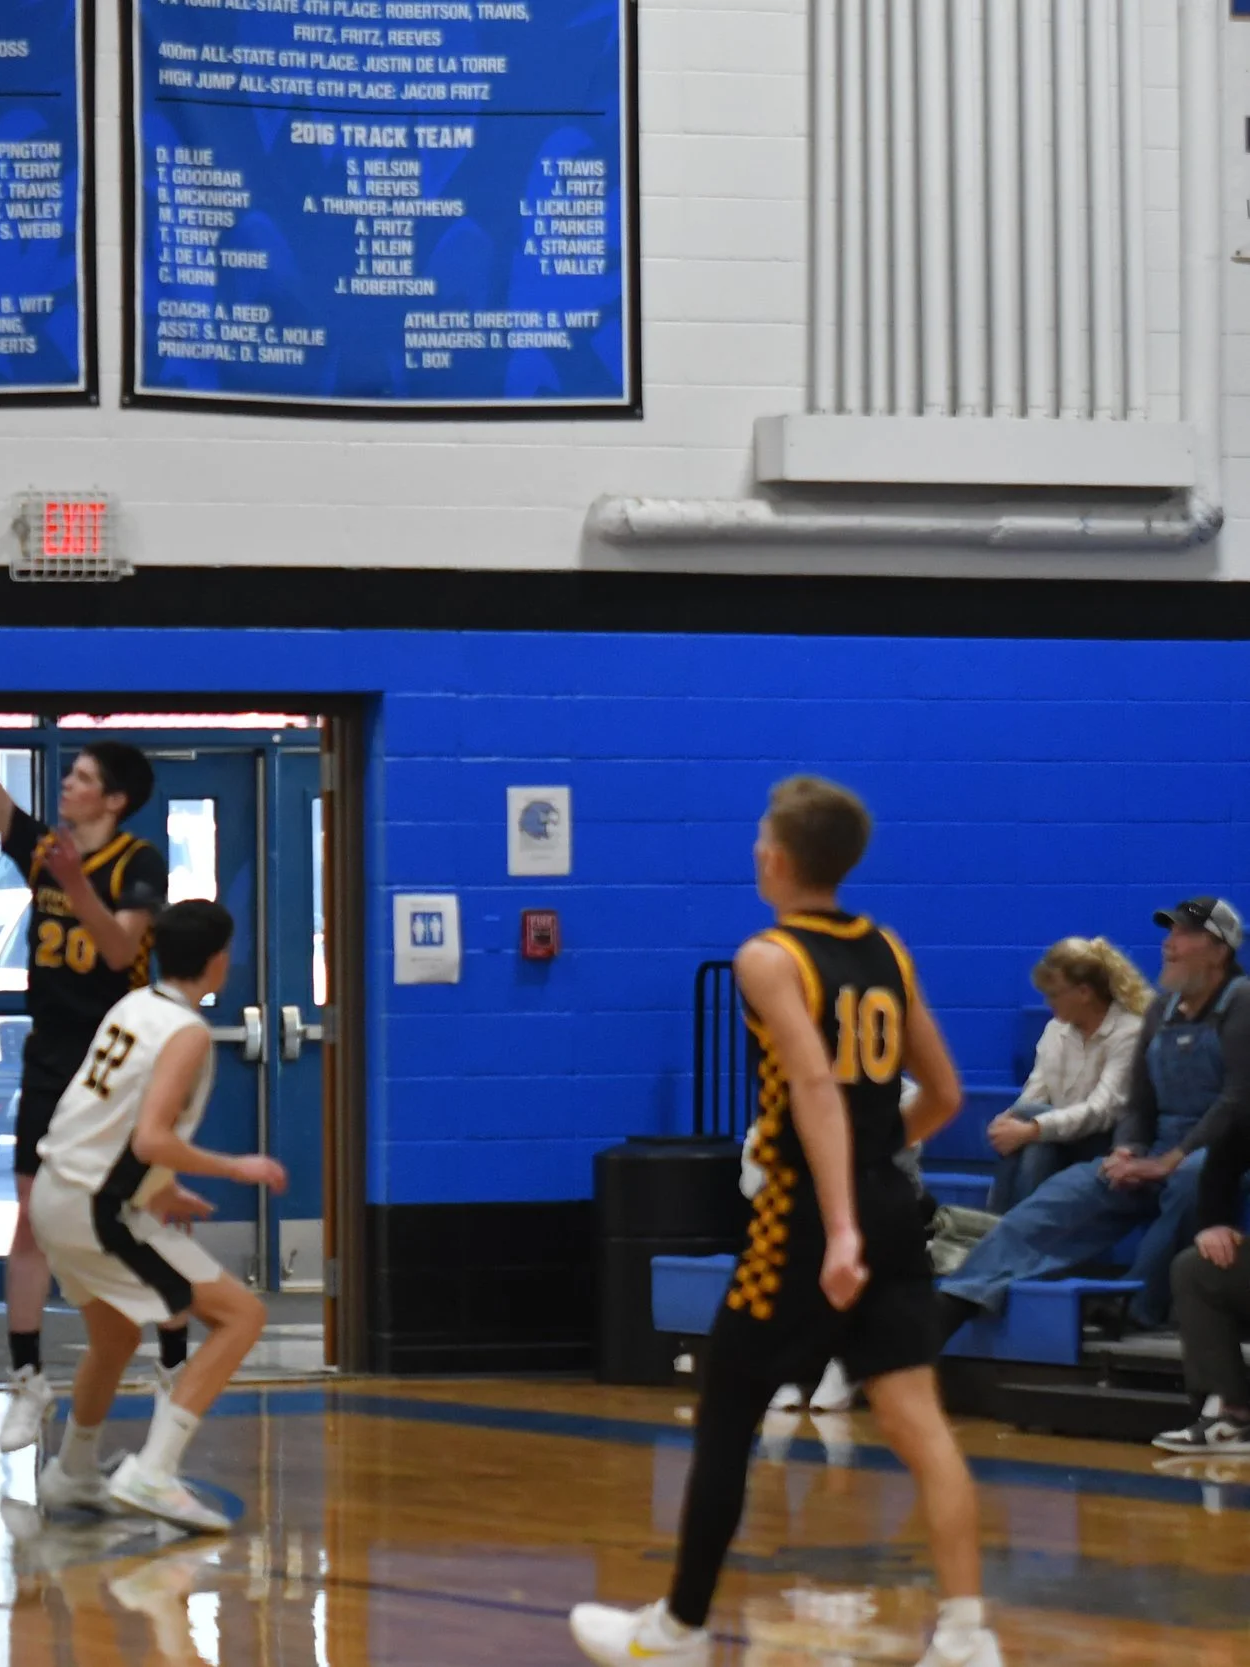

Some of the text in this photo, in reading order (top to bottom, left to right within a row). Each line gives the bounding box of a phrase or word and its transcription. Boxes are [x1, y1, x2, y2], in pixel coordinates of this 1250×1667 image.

[334, 1, 381, 18] PLACE:
[386, 3, 472, 22] ROBERTSON,
[477, 4, 530, 23] TRAVIS,
[293, 25, 442, 47] FRITZ, FRITZ, REEVES
[201, 45, 275, 66] ALL-STATE
[310, 52, 358, 71] PLACE:
[363, 56, 412, 72] JUSTIN
[415, 57, 435, 73] DE
[438, 57, 457, 73] LA
[461, 57, 506, 73] TORRE
[159, 69, 192, 87] HIGH
[196, 73, 236, 90] JUMP
[239, 75, 313, 96] ALL-STATE
[348, 82, 396, 100] PLACE:
[401, 84, 447, 100] JACOB
[451, 84, 491, 100] FRITZ
[291, 122, 474, 149] 2016 TRACK TEAM
[364, 161, 420, 177] NELSON
[557, 161, 604, 176] TRAVIS
[366, 181, 419, 196] REEVES
[567, 181, 604, 196] FRITZ
[322, 198, 463, 216] THUNDER-MATHEWS
[537, 200, 604, 216] LICKLIDER
[179, 208, 235, 227] PETERS
[18, 224, 61, 239] WEBB
[355, 220, 413, 236] A. FRITZ
[551, 220, 604, 236] PARKER
[372, 240, 412, 255] KLEIN
[541, 239, 605, 255] STRANGE
[175, 249, 193, 264] DE
[197, 250, 215, 266] LA
[221, 251, 268, 269] TORRE
[555, 260, 605, 274] VALLEY
[372, 260, 412, 276] NOLIE
[351, 279, 434, 295] ROBERTSON
[19, 296, 53, 313] WITT
[404, 312, 470, 328] ATHLETIC
[565, 312, 598, 327] WITT
[158, 340, 236, 360] PRINCIPAL:
[258, 347, 304, 365] SMITH
[45, 503, 106, 555] EXIT
[35, 918, 96, 974] 20
[832, 984, 899, 1084] 10
[81, 1024, 136, 1100] 22
